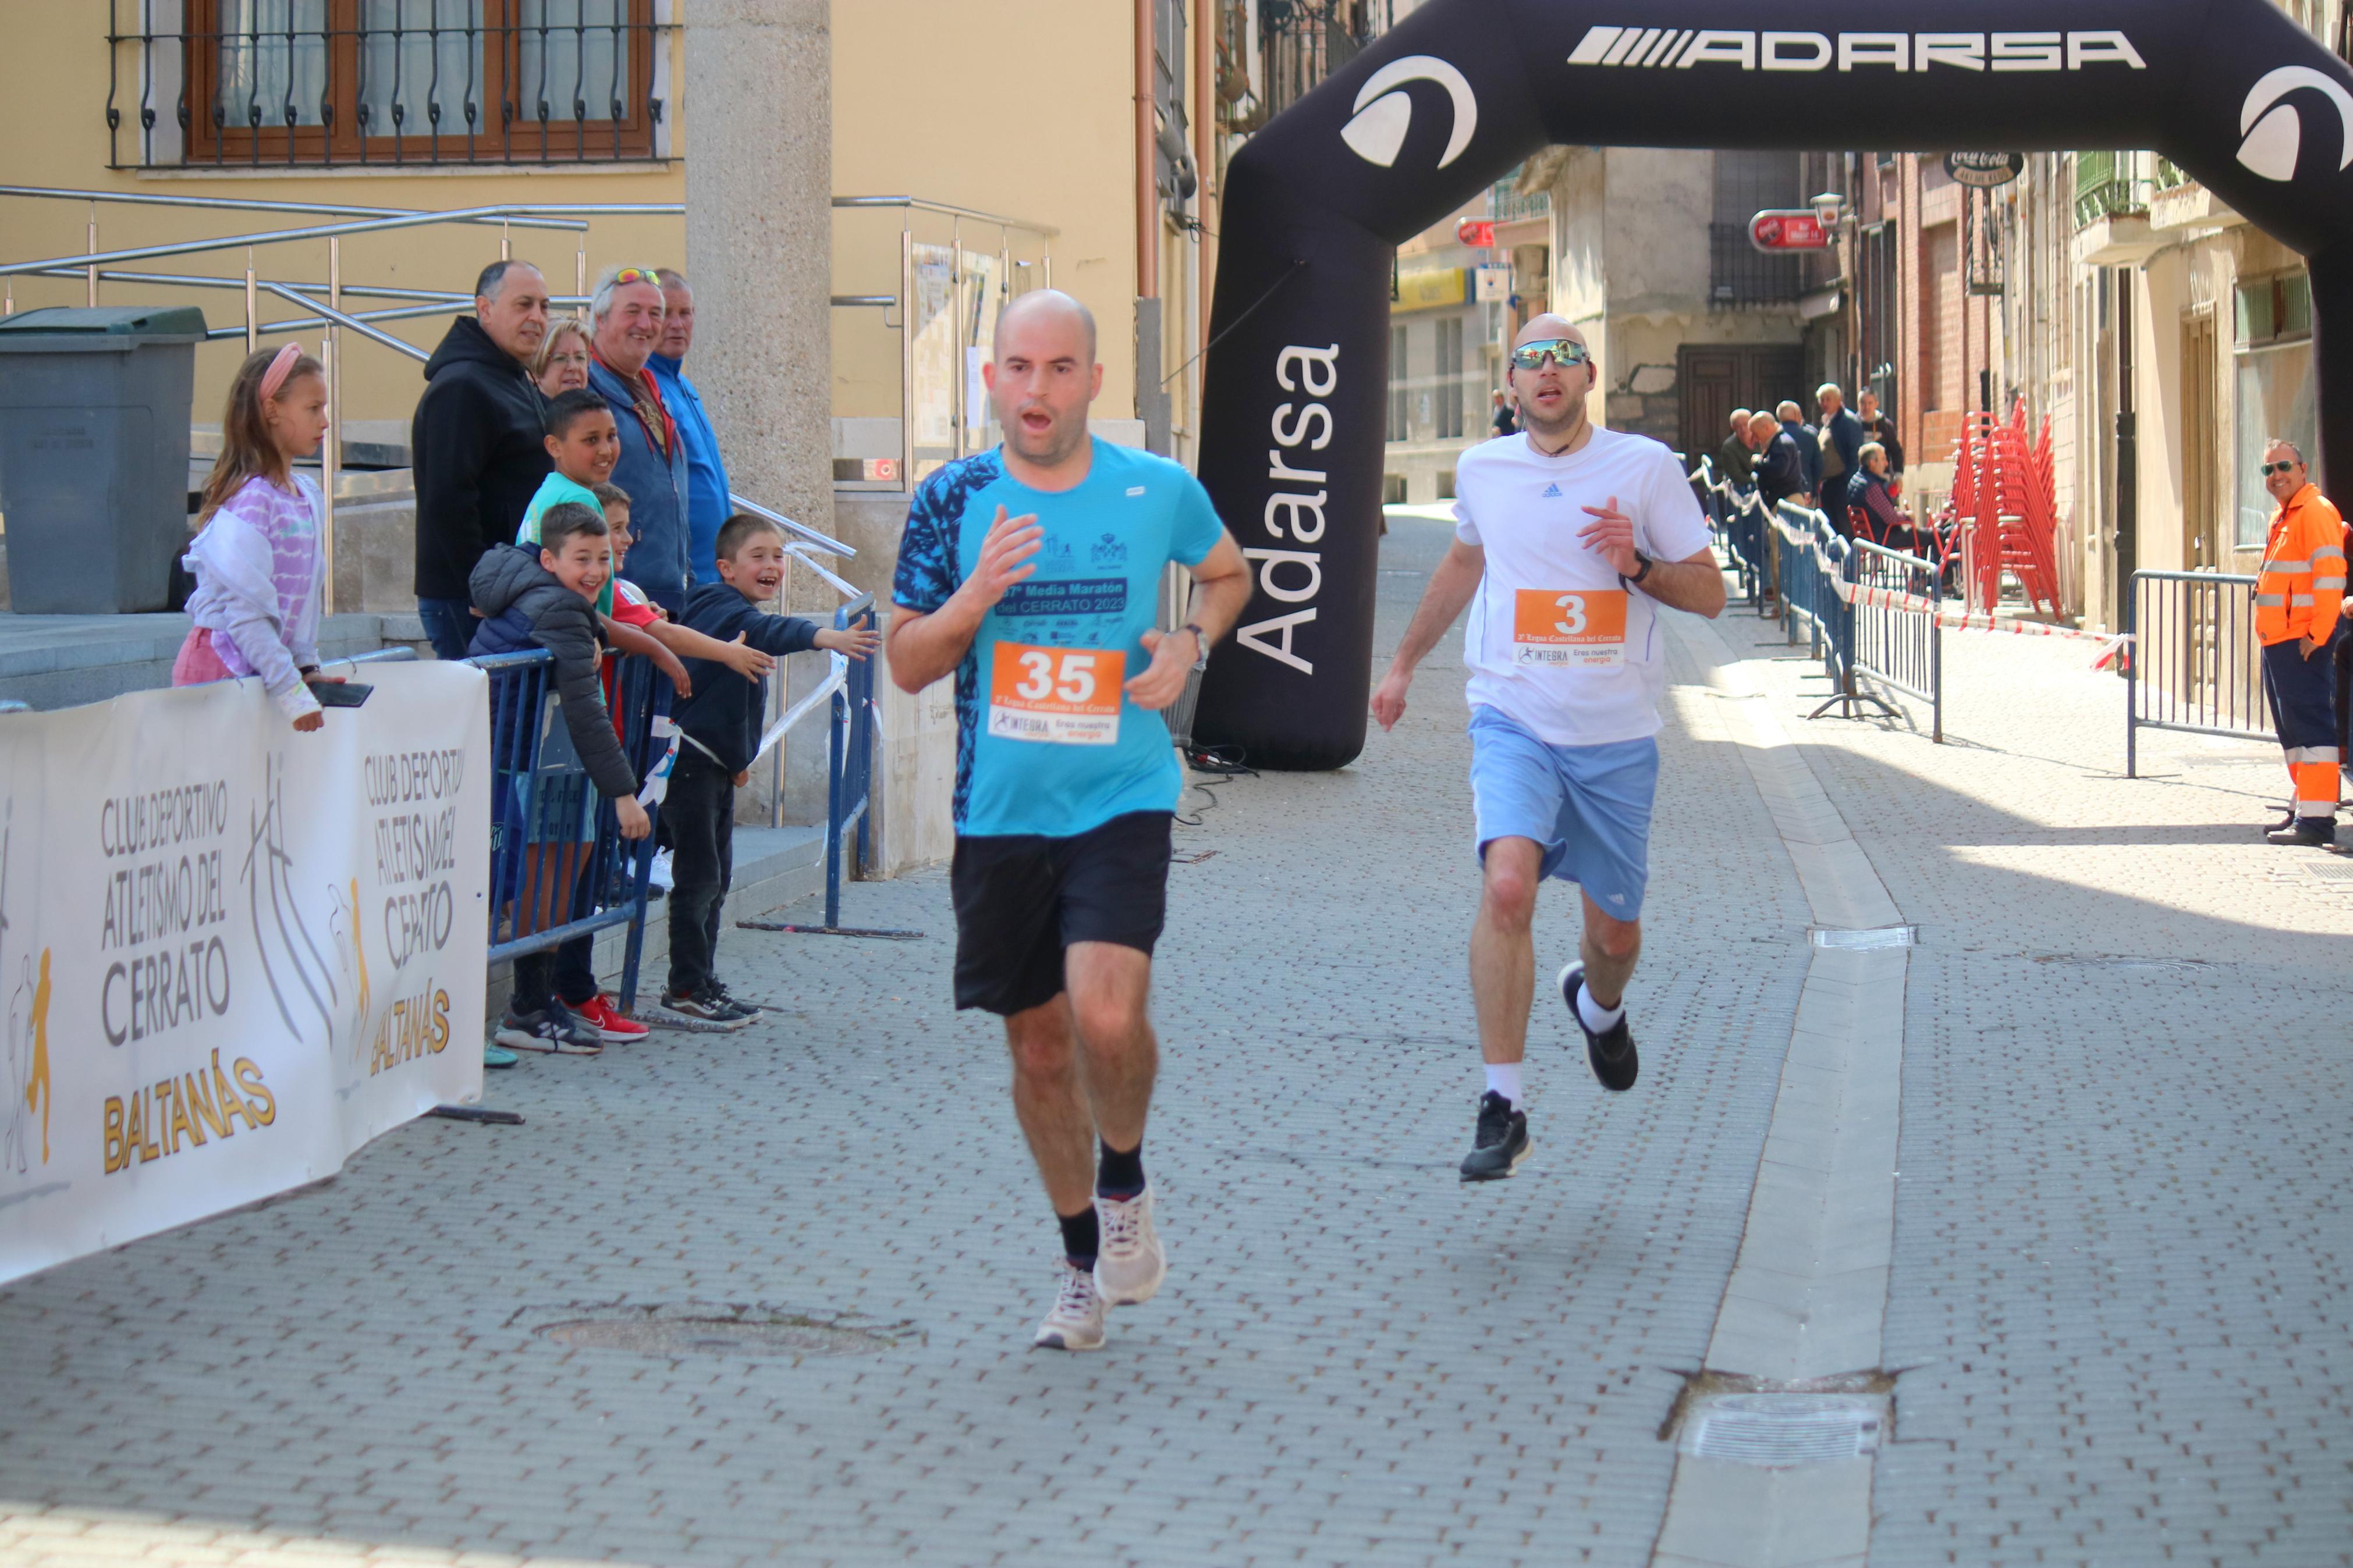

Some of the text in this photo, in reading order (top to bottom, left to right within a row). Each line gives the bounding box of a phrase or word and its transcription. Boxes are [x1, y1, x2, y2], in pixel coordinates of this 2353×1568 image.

[1676, 30, 2146, 72] ADARSA
[1236, 343, 1339, 675] Adarsa
[997, 597, 1125, 613] del CERRATO 2023
[1025, 584, 1066, 597] Media
[1069, 581, 1123, 595] Maratón
[1555, 595, 1587, 635] 3
[1535, 648, 1618, 662] INTEGRA Eres nuestra
[1548, 634, 1585, 642] Castellana
[1016, 651, 1095, 703] 35
[1010, 716, 1048, 733] INTEGRA
[364, 749, 466, 807] CLUB DEPORT
[101, 778, 228, 858] CLUB DEPORTIVO
[101, 848, 226, 951] ATLETISMO DEL
[101, 934, 230, 1047] CERRATO
[370, 976, 450, 1078] BALTANÁS
[104, 1046, 276, 1176] BALTANÁS
